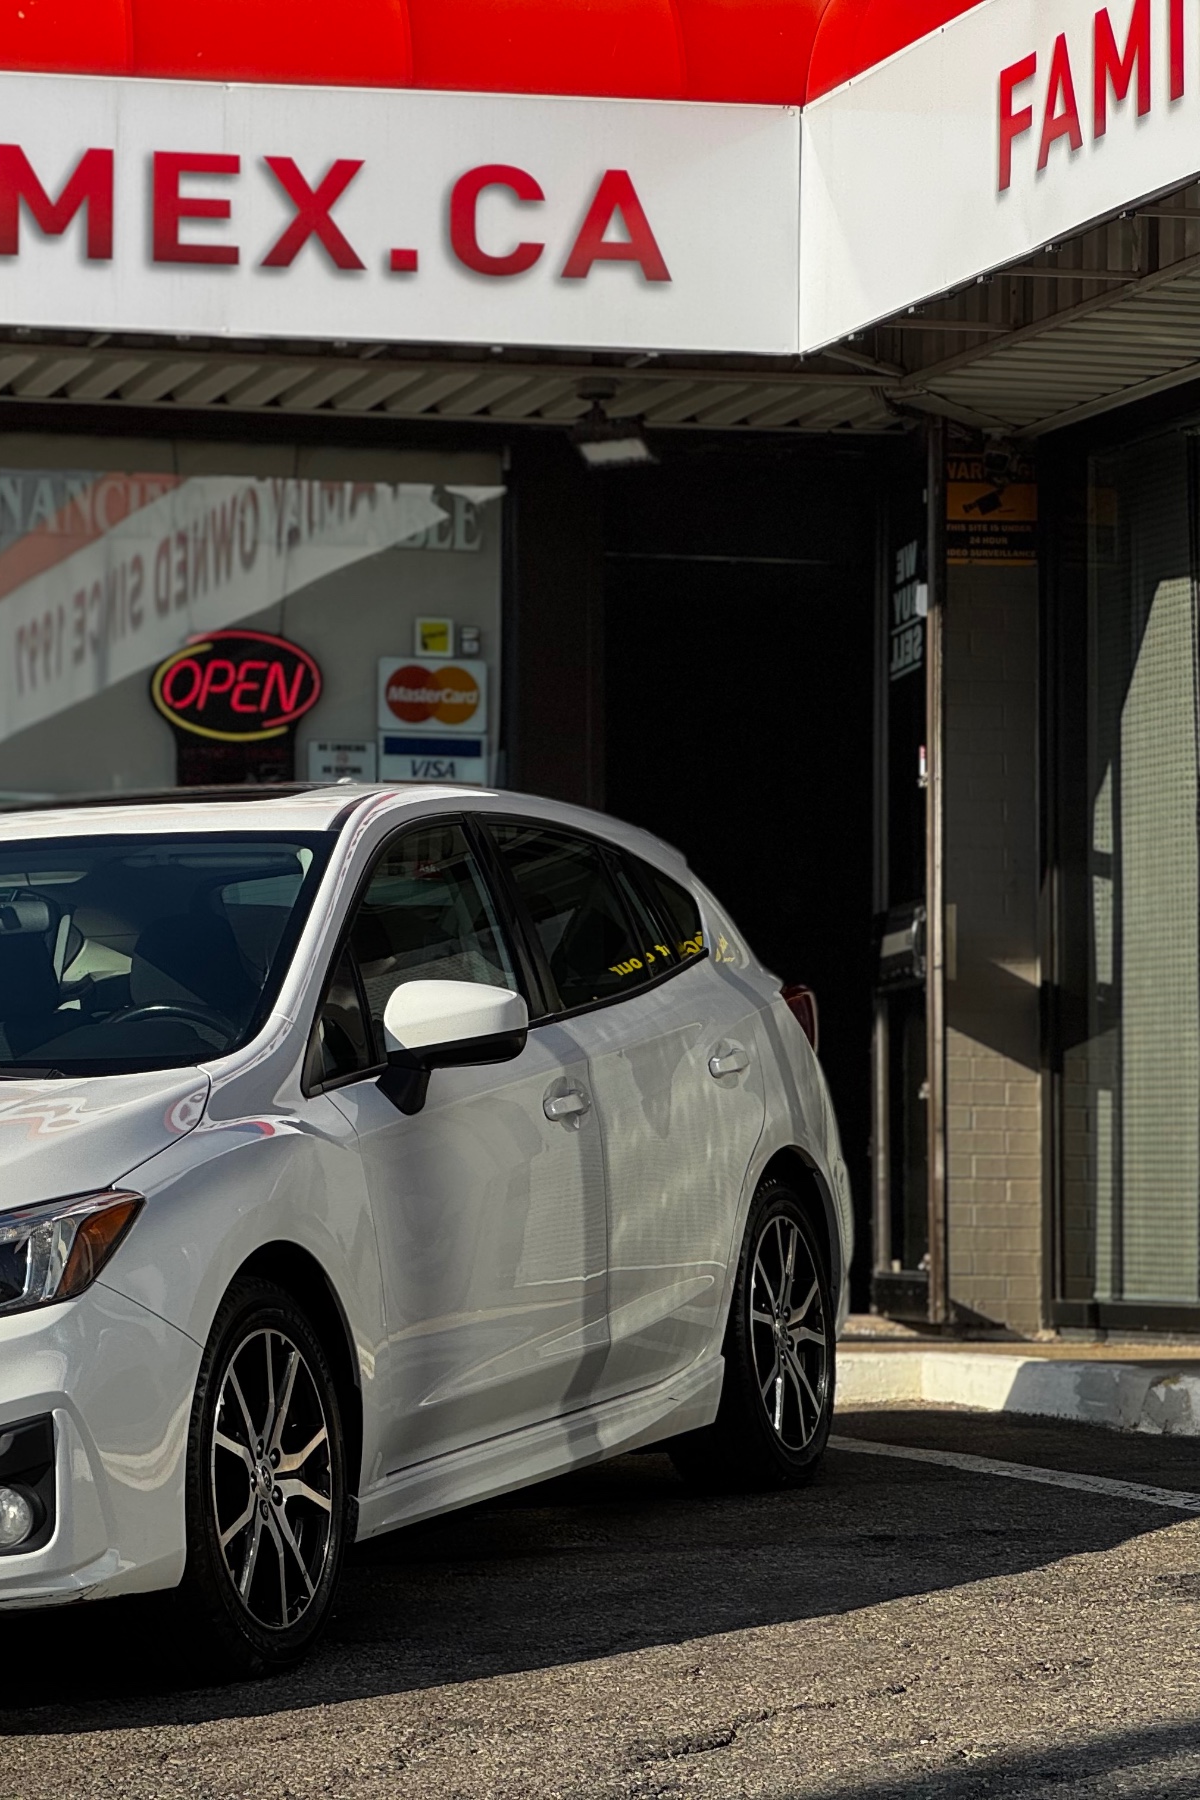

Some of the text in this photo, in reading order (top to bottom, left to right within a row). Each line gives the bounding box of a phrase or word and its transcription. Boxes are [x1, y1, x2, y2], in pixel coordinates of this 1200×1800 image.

[999, 0, 1184, 192] FAMI
[969, 523, 988, 532] SITE
[969, 536, 1008, 545] 24 HOUR
[947, 548, 1037, 558] IDEO SURVEILLANCE
[162, 659, 305, 712] OPEN
[387, 685, 478, 705] MasterCard
[410, 759, 456, 779] VISA
